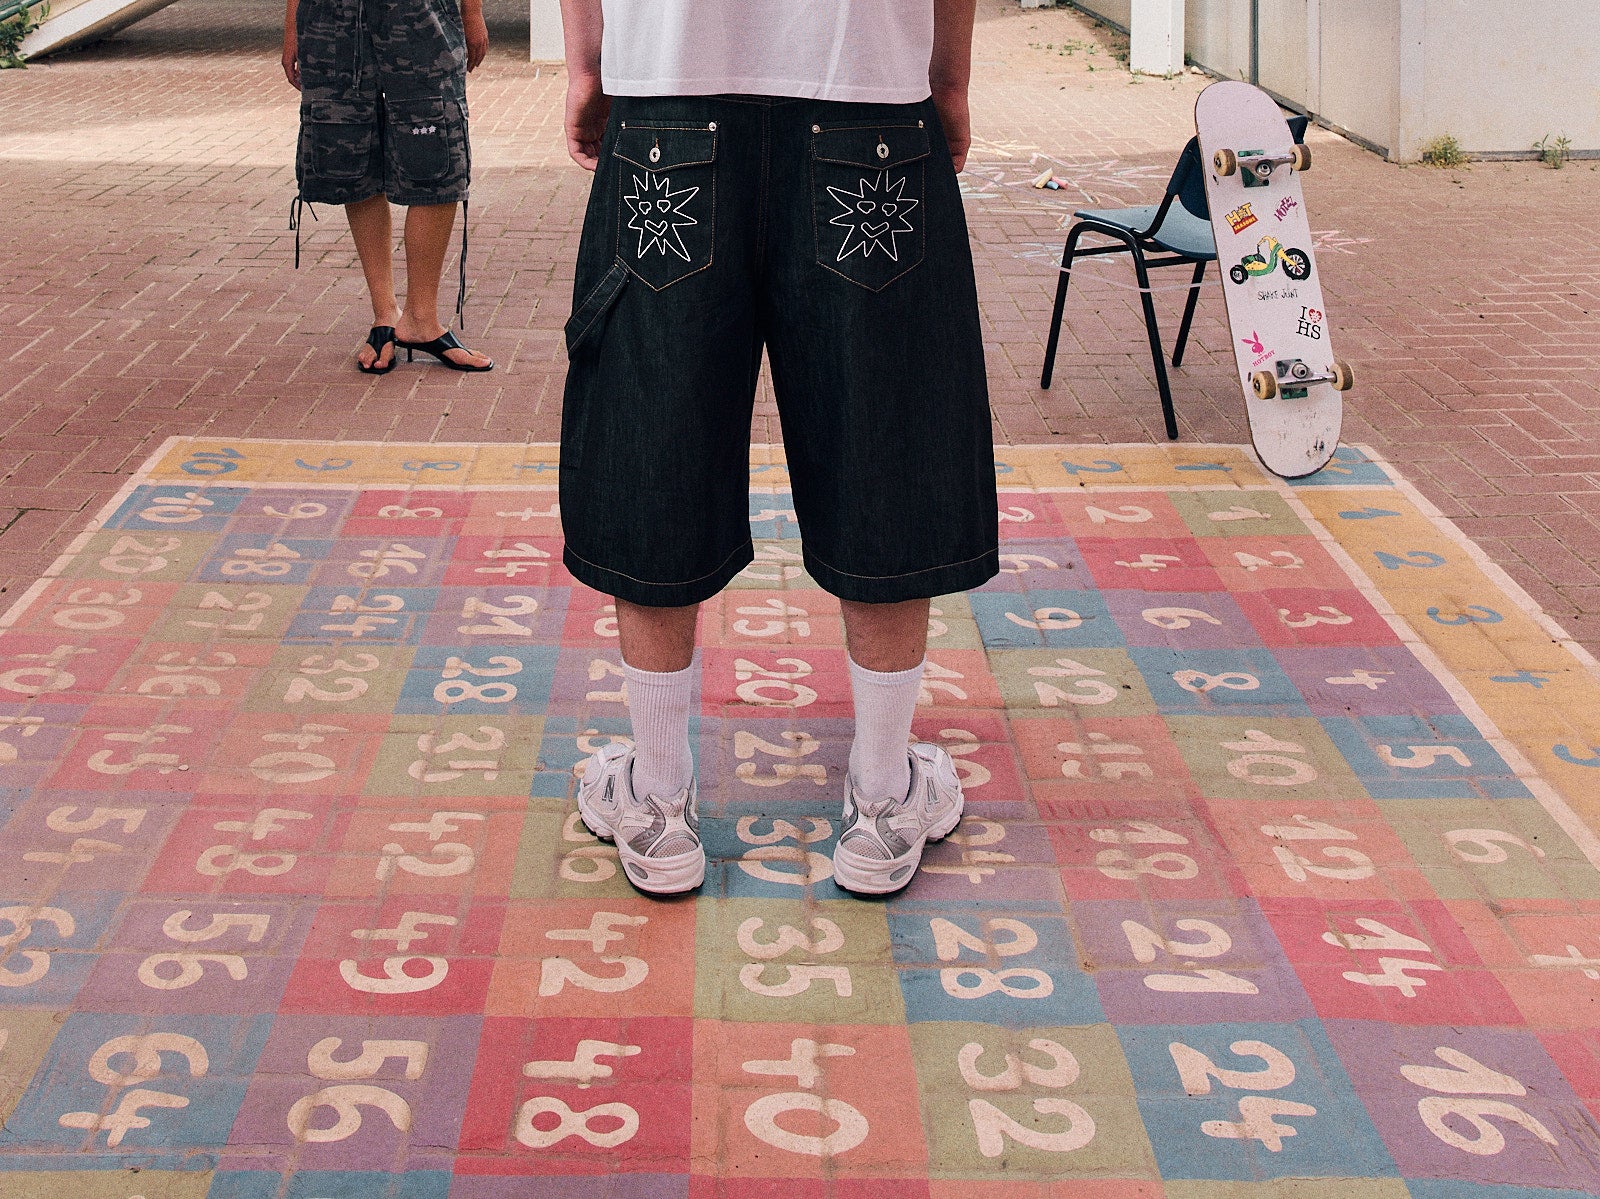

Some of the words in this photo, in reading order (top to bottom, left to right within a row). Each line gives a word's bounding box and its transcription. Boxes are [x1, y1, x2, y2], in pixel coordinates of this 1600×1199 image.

[1295, 319, 1322, 340] HS
[1300, 305, 1308, 320] I
[1252, 349, 1276, 367] HOTBOY
[180, 448, 245, 476] 10
[1061, 459, 1123, 476] 2
[139, 492, 214, 524] 10
[264, 502, 327, 520] 9
[379, 504, 443, 520] 8
[1085, 505, 1153, 525] 2
[1207, 505, 1271, 522] 1
[100, 536, 181, 574] 20
[221, 542, 301, 577] 18
[348, 543, 427, 578] 16
[474, 543, 552, 578] 14
[1115, 554, 1181, 573] 4
[1233, 550, 1304, 573] 2
[1375, 550, 1445, 570] 2
[52, 587, 143, 630] 30
[321, 595, 405, 638] 24
[457, 595, 538, 638] 21
[732, 598, 811, 638] 15
[1005, 606, 1081, 630] 9
[1141, 606, 1223, 629] 6
[1277, 605, 1354, 629] 3
[1427, 604, 1503, 626] 3
[284, 652, 380, 702] 32
[433, 655, 523, 704] 28
[734, 657, 818, 708] 20
[1027, 658, 1118, 707] 12
[1172, 669, 1261, 693] 8
[1324, 668, 1395, 689] 4
[250, 723, 349, 783] 40
[408, 726, 508, 781] 35
[733, 729, 827, 788] 25
[1219, 729, 1318, 786] 10
[1376, 743, 1472, 769] 5
[23, 806, 147, 864] 54
[196, 807, 313, 877] 48
[375, 810, 488, 881] 42
[736, 815, 835, 886] 30
[1089, 820, 1199, 881] 18
[1260, 814, 1376, 882] 12
[1443, 828, 1546, 864] 6
[138, 909, 271, 990] 56
[339, 911, 458, 994] 49
[538, 911, 649, 997] 42
[737, 916, 853, 998] 35
[930, 917, 1055, 1000] 28
[1122, 918, 1260, 996] 21
[1322, 917, 1443, 998] 14
[59, 1032, 210, 1148] 64
[287, 1036, 430, 1144] 56
[516, 1038, 642, 1149] 48
[741, 1037, 870, 1157] 40
[957, 1037, 1096, 1158] 32
[1168, 1039, 1318, 1153] 24
[1400, 1046, 1560, 1156] 16
